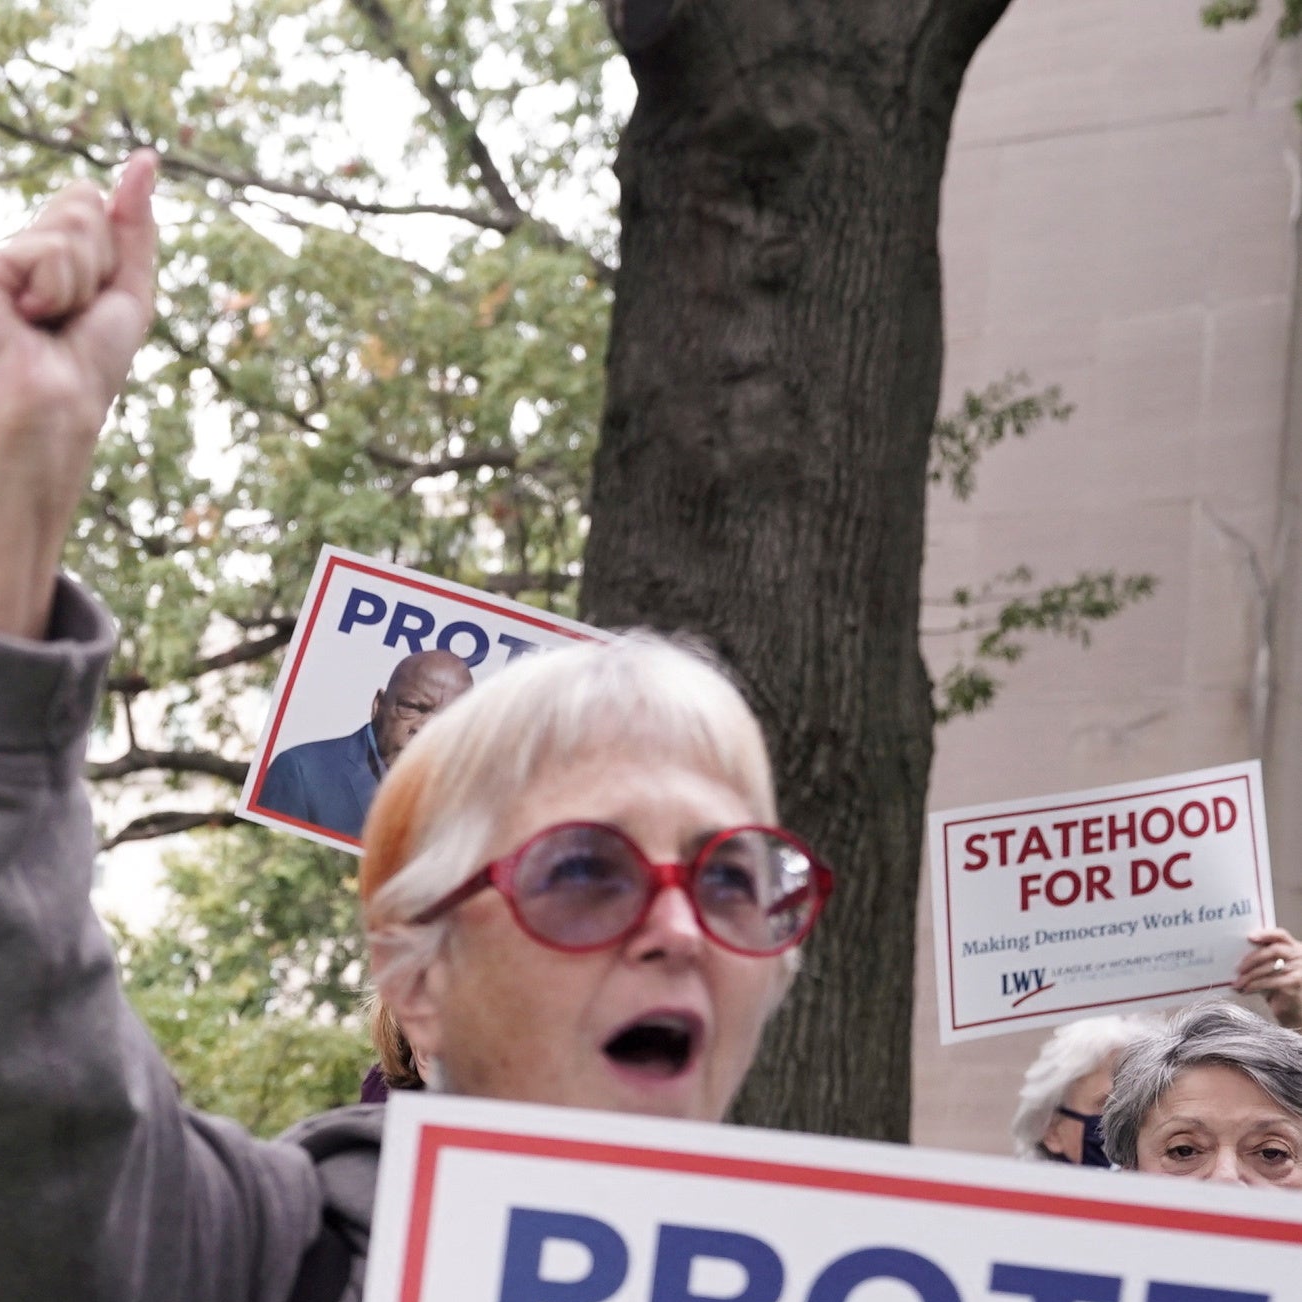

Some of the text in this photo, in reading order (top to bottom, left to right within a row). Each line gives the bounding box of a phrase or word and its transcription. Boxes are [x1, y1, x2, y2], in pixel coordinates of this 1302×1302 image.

[963, 796, 1237, 871] STATEHOOD
[1019, 852, 1193, 911] FOR DC
[962, 899, 1252, 957] Making Democracy Work for All
[1001, 967, 1046, 996] LWV
